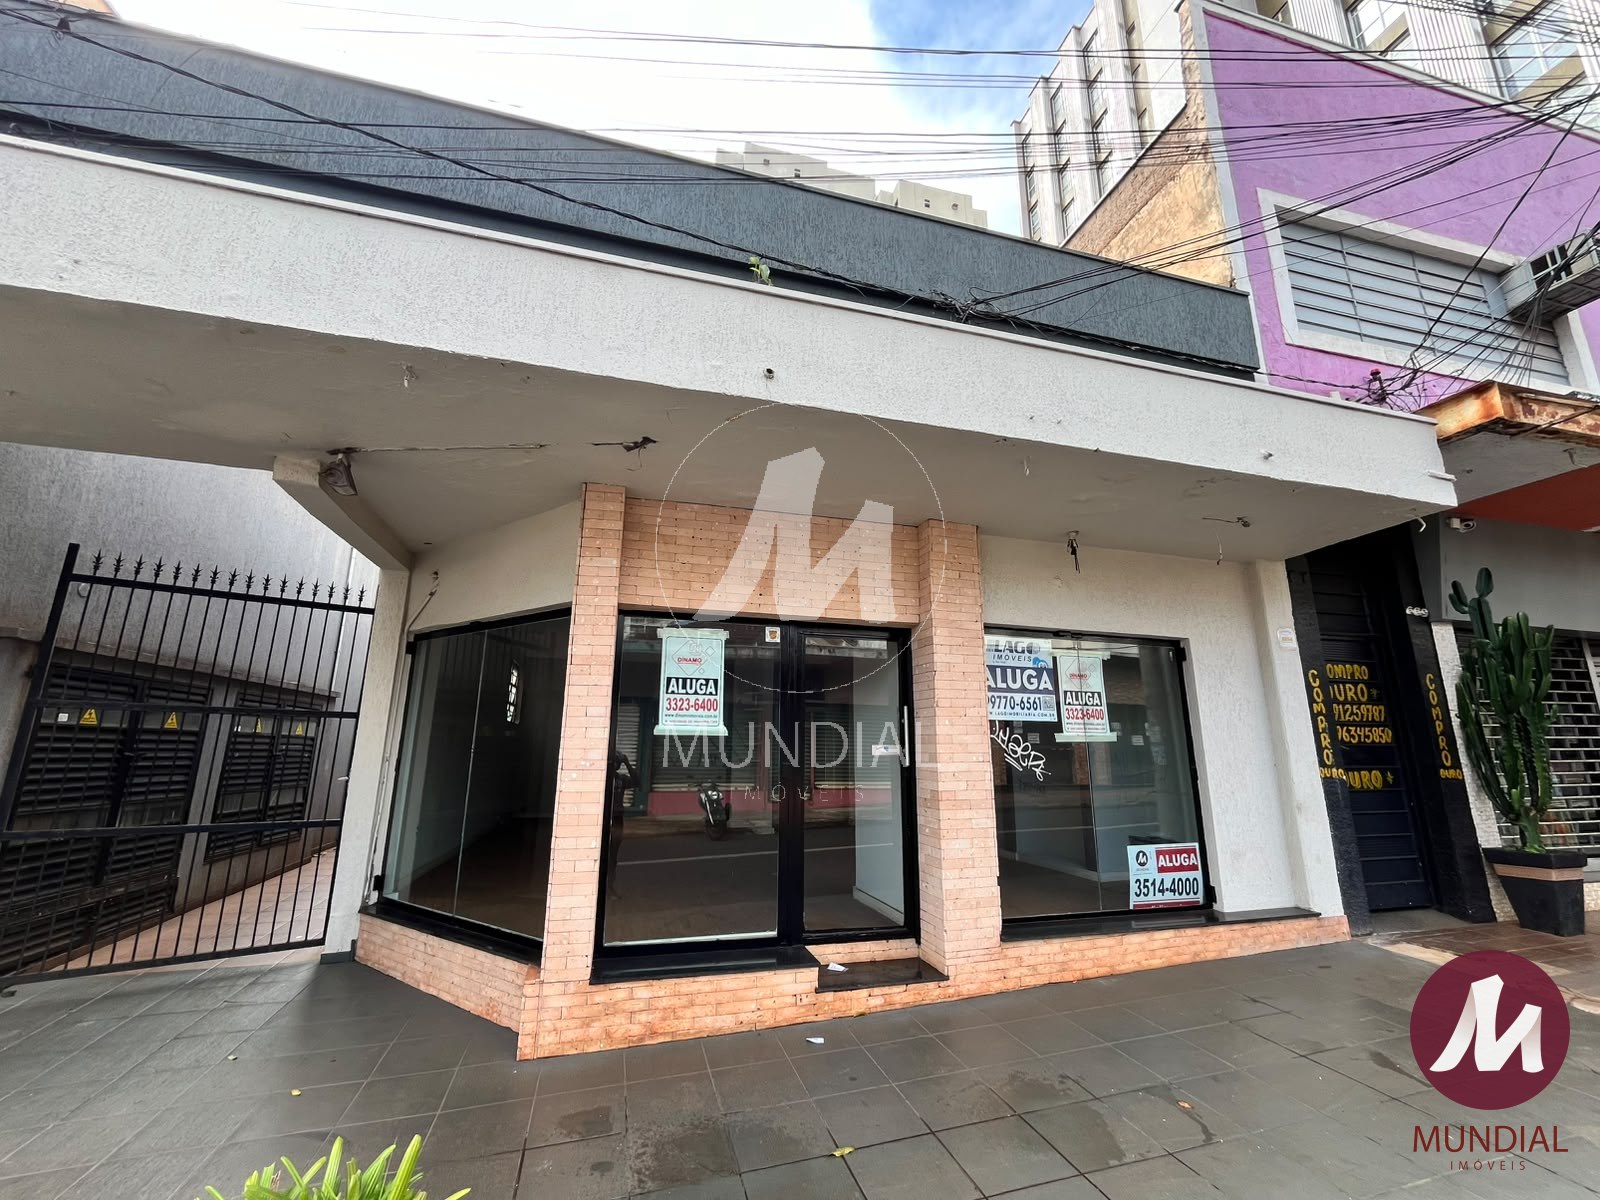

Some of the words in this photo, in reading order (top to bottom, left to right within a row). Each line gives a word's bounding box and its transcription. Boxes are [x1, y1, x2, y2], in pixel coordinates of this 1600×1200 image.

[987, 668, 1053, 690] ALUGA
[1326, 663, 1369, 680] OMPRO
[667, 678, 716, 695] ALUGA
[1328, 683, 1368, 702] URO
[665, 697, 718, 712] 3323-6400
[988, 694, 1042, 711] 9770-6561
[1065, 691, 1101, 706] ALUGA
[1065, 707, 1105, 721] 3323-6400
[1425, 673, 1451, 766] COMPRO
[1346, 770, 1383, 789] URO
[1439, 768, 1463, 780] OURO
[1158, 853, 1198, 868] ALUGA
[1134, 877, 1199, 898] 3514-4000
